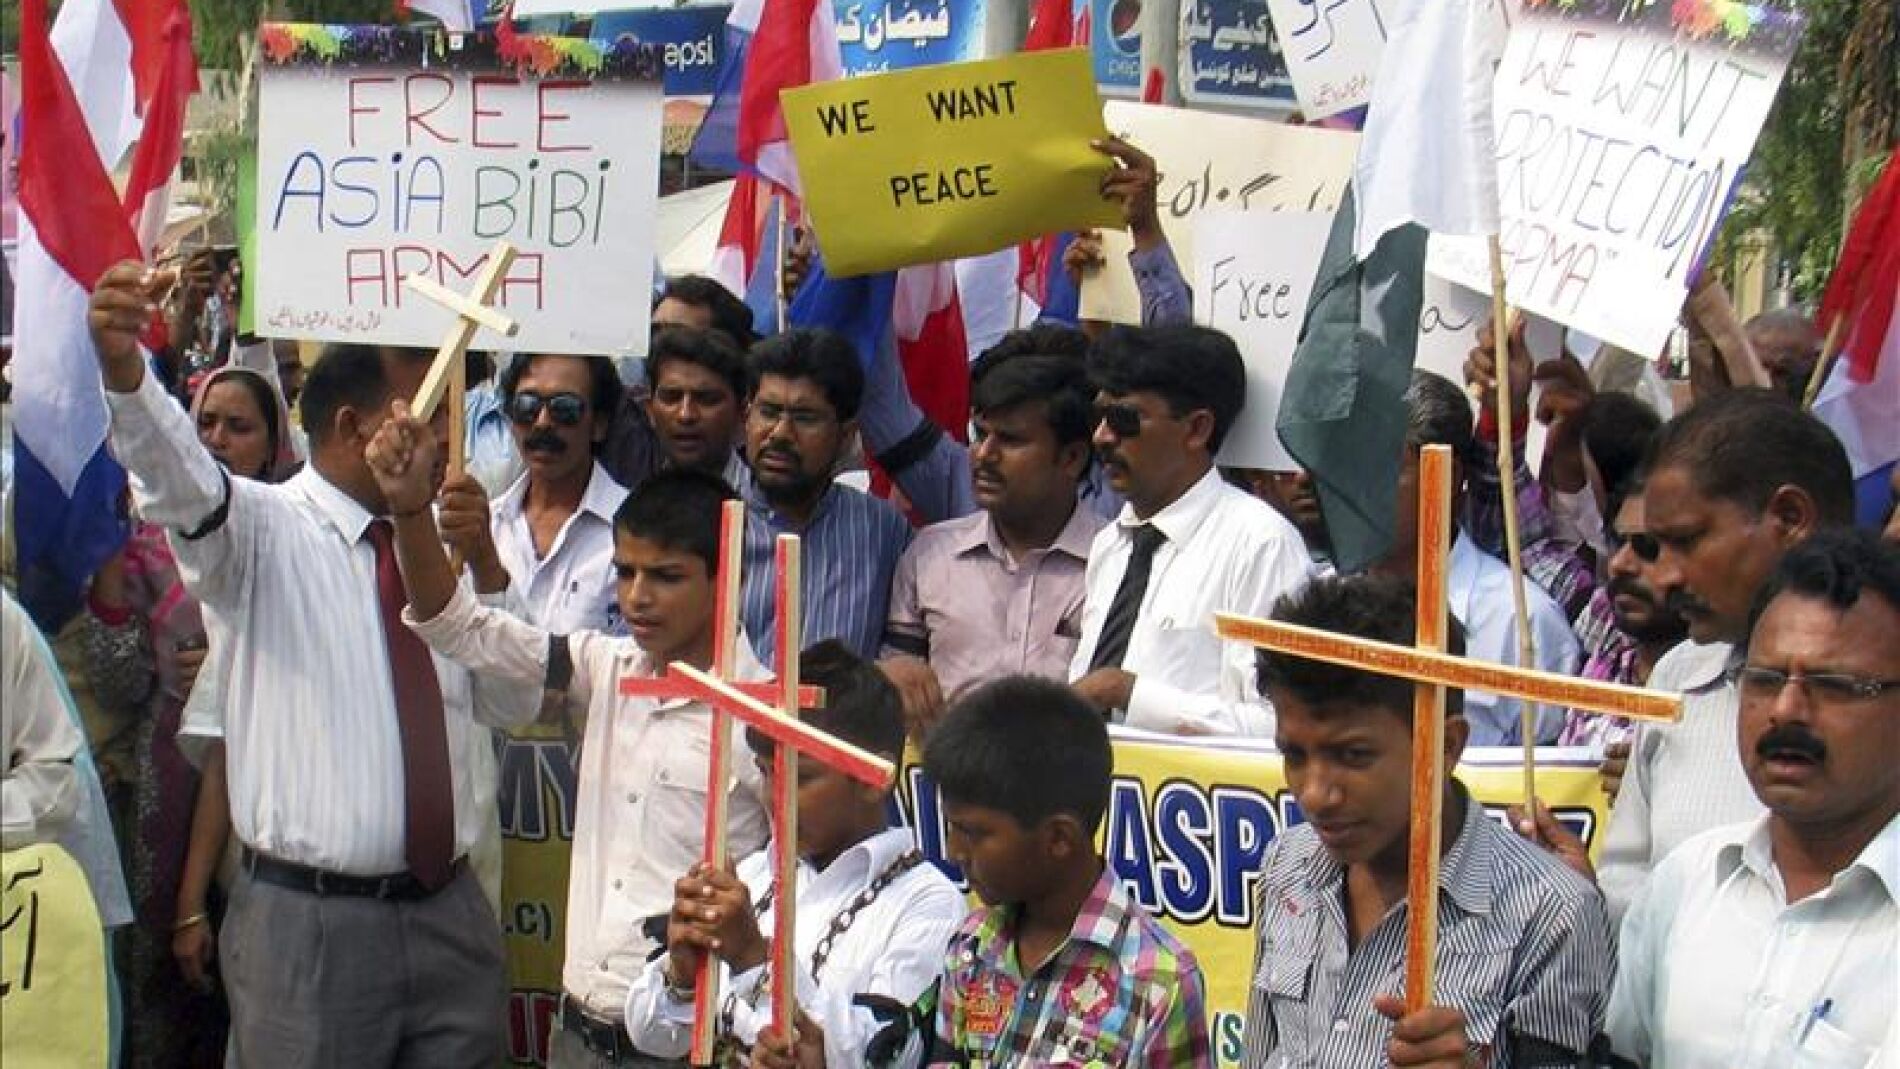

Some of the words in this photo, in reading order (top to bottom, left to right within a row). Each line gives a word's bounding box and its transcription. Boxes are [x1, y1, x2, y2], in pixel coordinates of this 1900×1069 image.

[664, 36, 714, 71] epsi
[1519, 28, 1597, 96] WE
[1592, 35, 1768, 149] WANT
[349, 74, 593, 152] FREE
[817, 101, 875, 138] WE
[926, 80, 1018, 122] WANT
[890, 165, 998, 207] PEACE
[1209, 256, 1292, 326] Free
[1107, 776, 1303, 924] ASP
